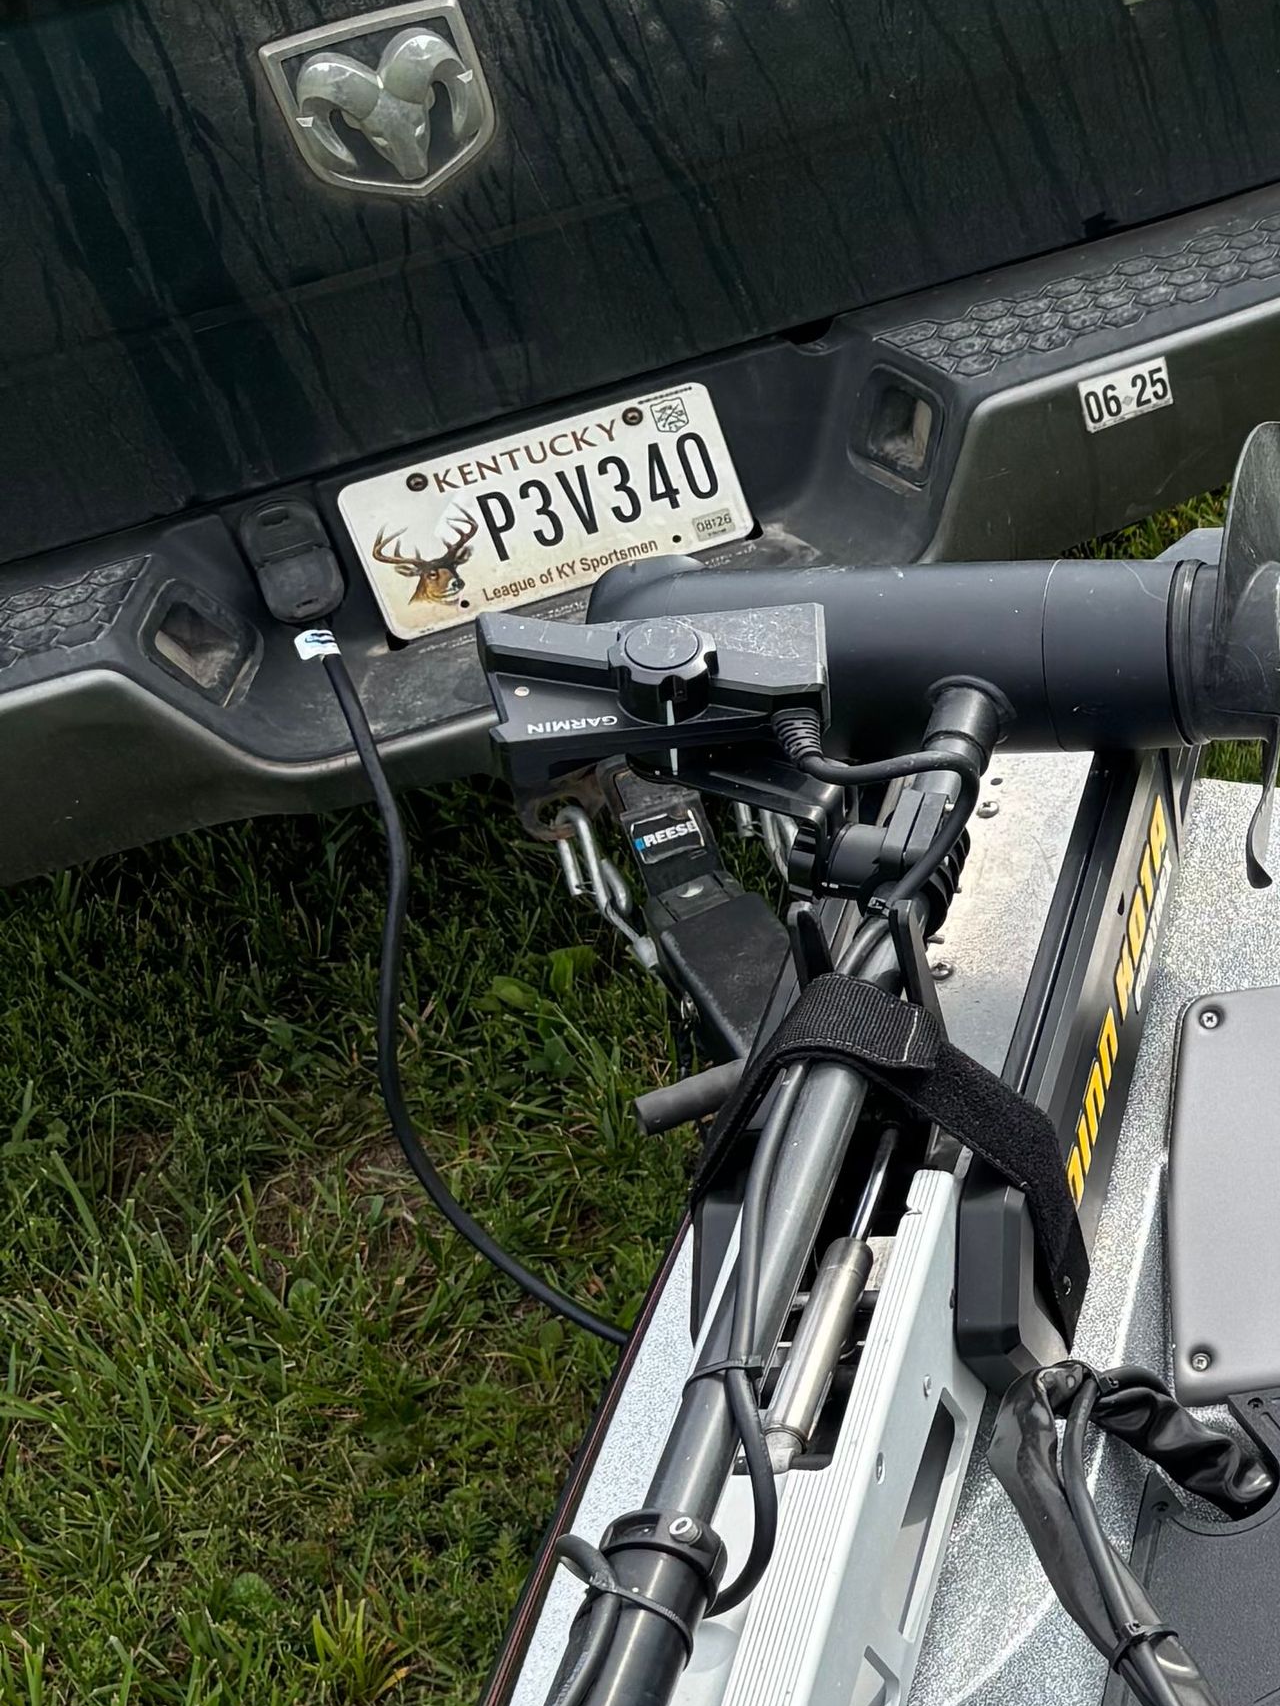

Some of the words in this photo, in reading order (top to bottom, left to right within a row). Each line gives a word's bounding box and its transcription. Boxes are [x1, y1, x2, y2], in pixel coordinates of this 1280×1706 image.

[1084, 384, 1122, 424] 06
[1131, 366, 1168, 408] 25
[432, 418, 616, 493] KENTUCKY
[476, 431, 719, 562] P3V340
[482, 577, 537, 602] League
[539, 567, 553, 585] of
[556, 560, 577, 581] KY
[580, 539, 658, 573] Sportsmen
[527, 715, 618, 735] GARMIN
